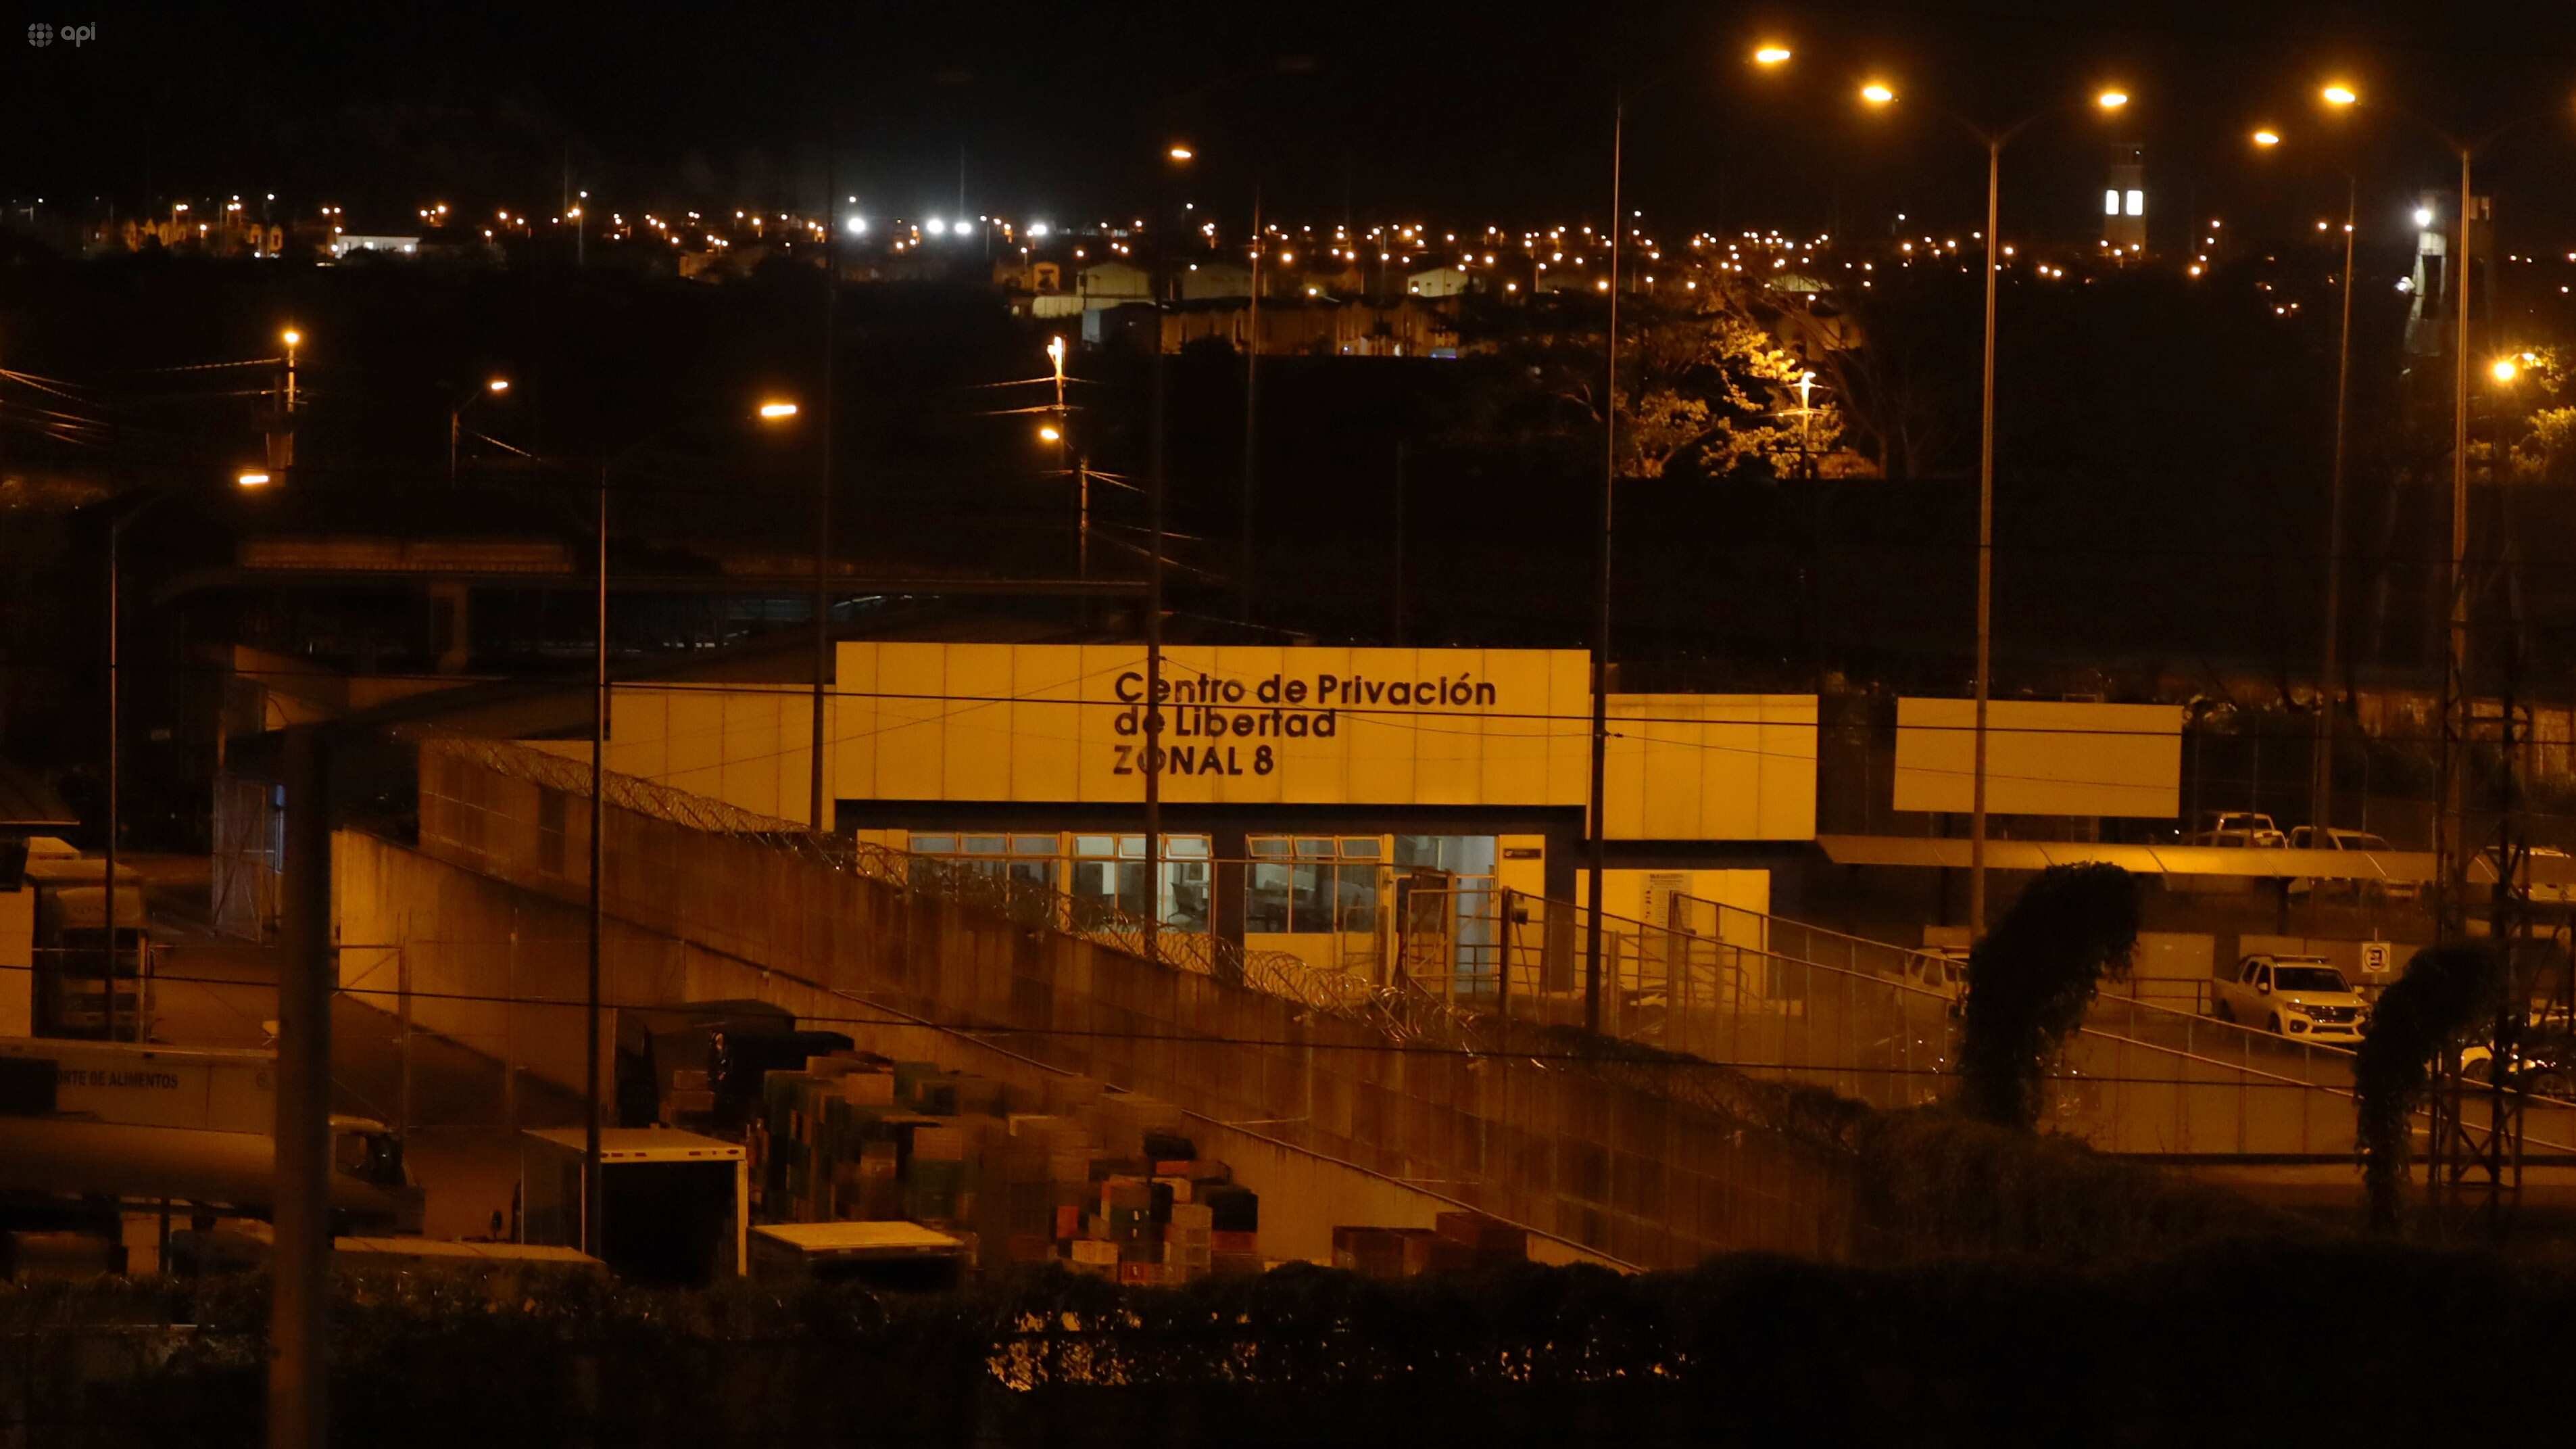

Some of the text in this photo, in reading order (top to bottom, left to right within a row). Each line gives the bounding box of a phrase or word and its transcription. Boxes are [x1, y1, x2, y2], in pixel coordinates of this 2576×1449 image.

[1115, 671, 1497, 706] Centro de Privación
[1115, 705, 1336, 738] de Libertad
[1114, 745, 1275, 776] ZONAL 8
[89, 1070, 105, 1087] DE
[108, 1071, 178, 1089] ALIMENTOS
